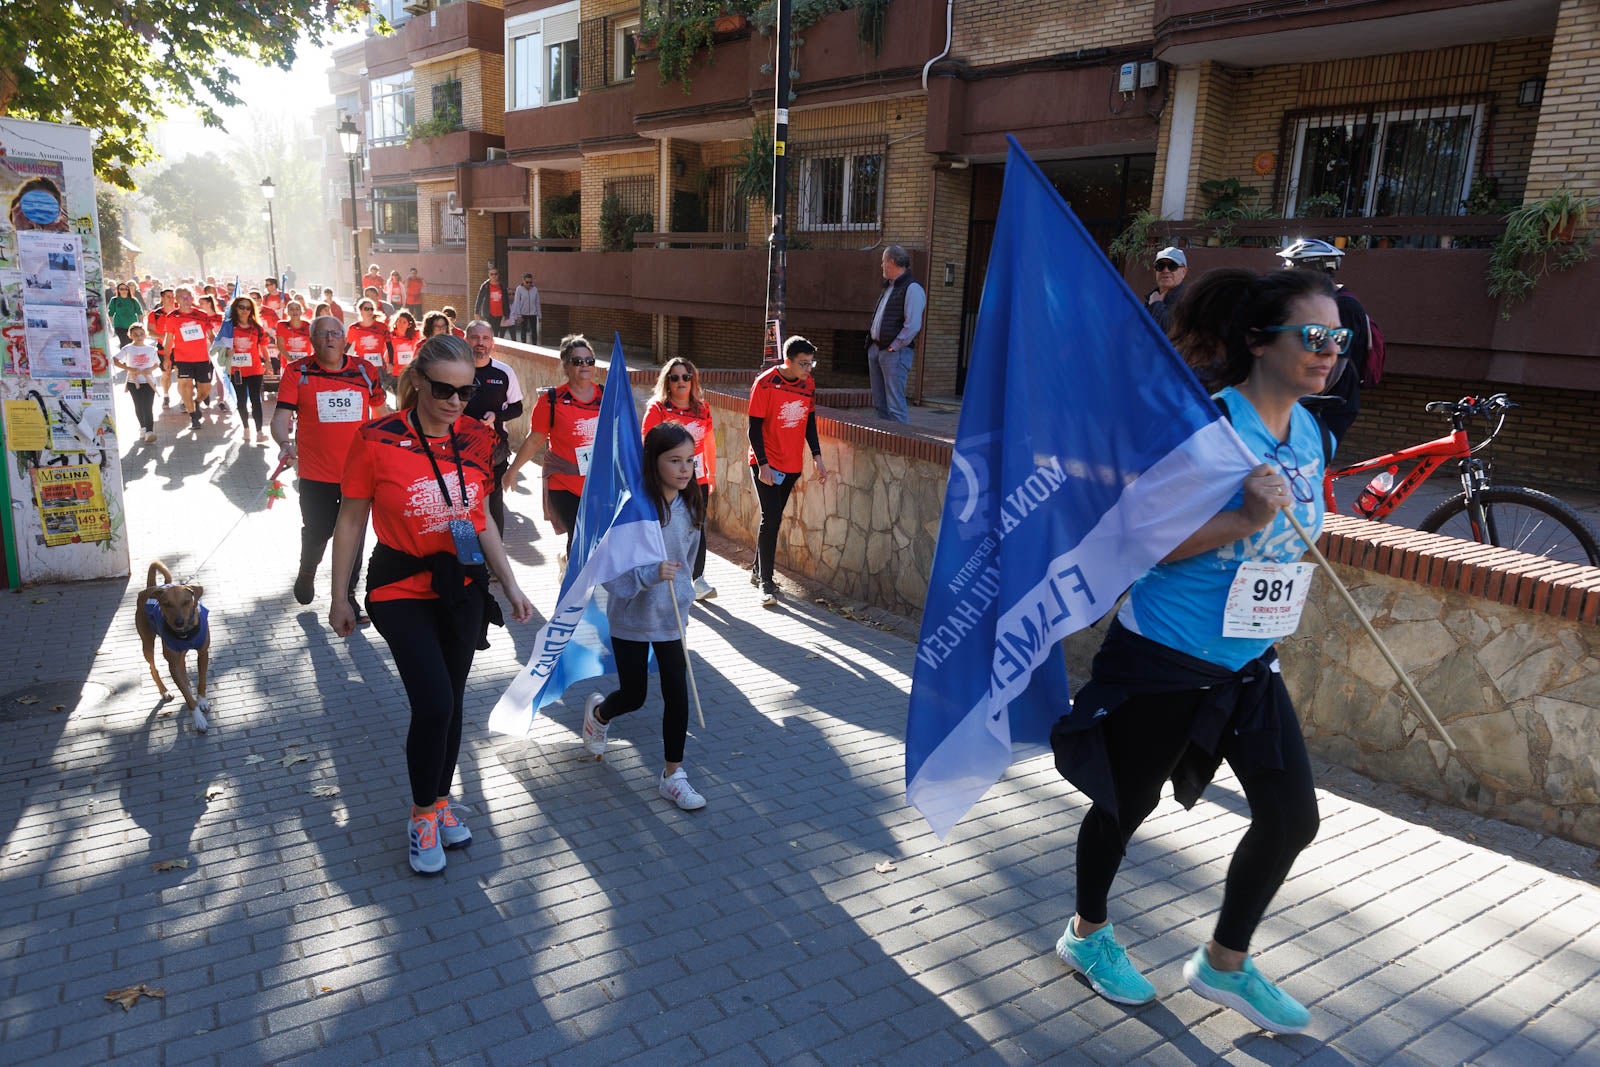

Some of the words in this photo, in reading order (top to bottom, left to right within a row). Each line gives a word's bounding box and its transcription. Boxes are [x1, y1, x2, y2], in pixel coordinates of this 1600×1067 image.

[39, 151, 87, 162] Ayuntamiento
[328, 398, 351, 408] 558
[41, 471, 89, 481] MOLINA
[1385, 458, 1433, 509] TREK
[411, 487, 475, 505] carea
[78, 514, 96, 525] 149
[99, 513, 107, 523] €
[1252, 578, 1294, 602] 981
